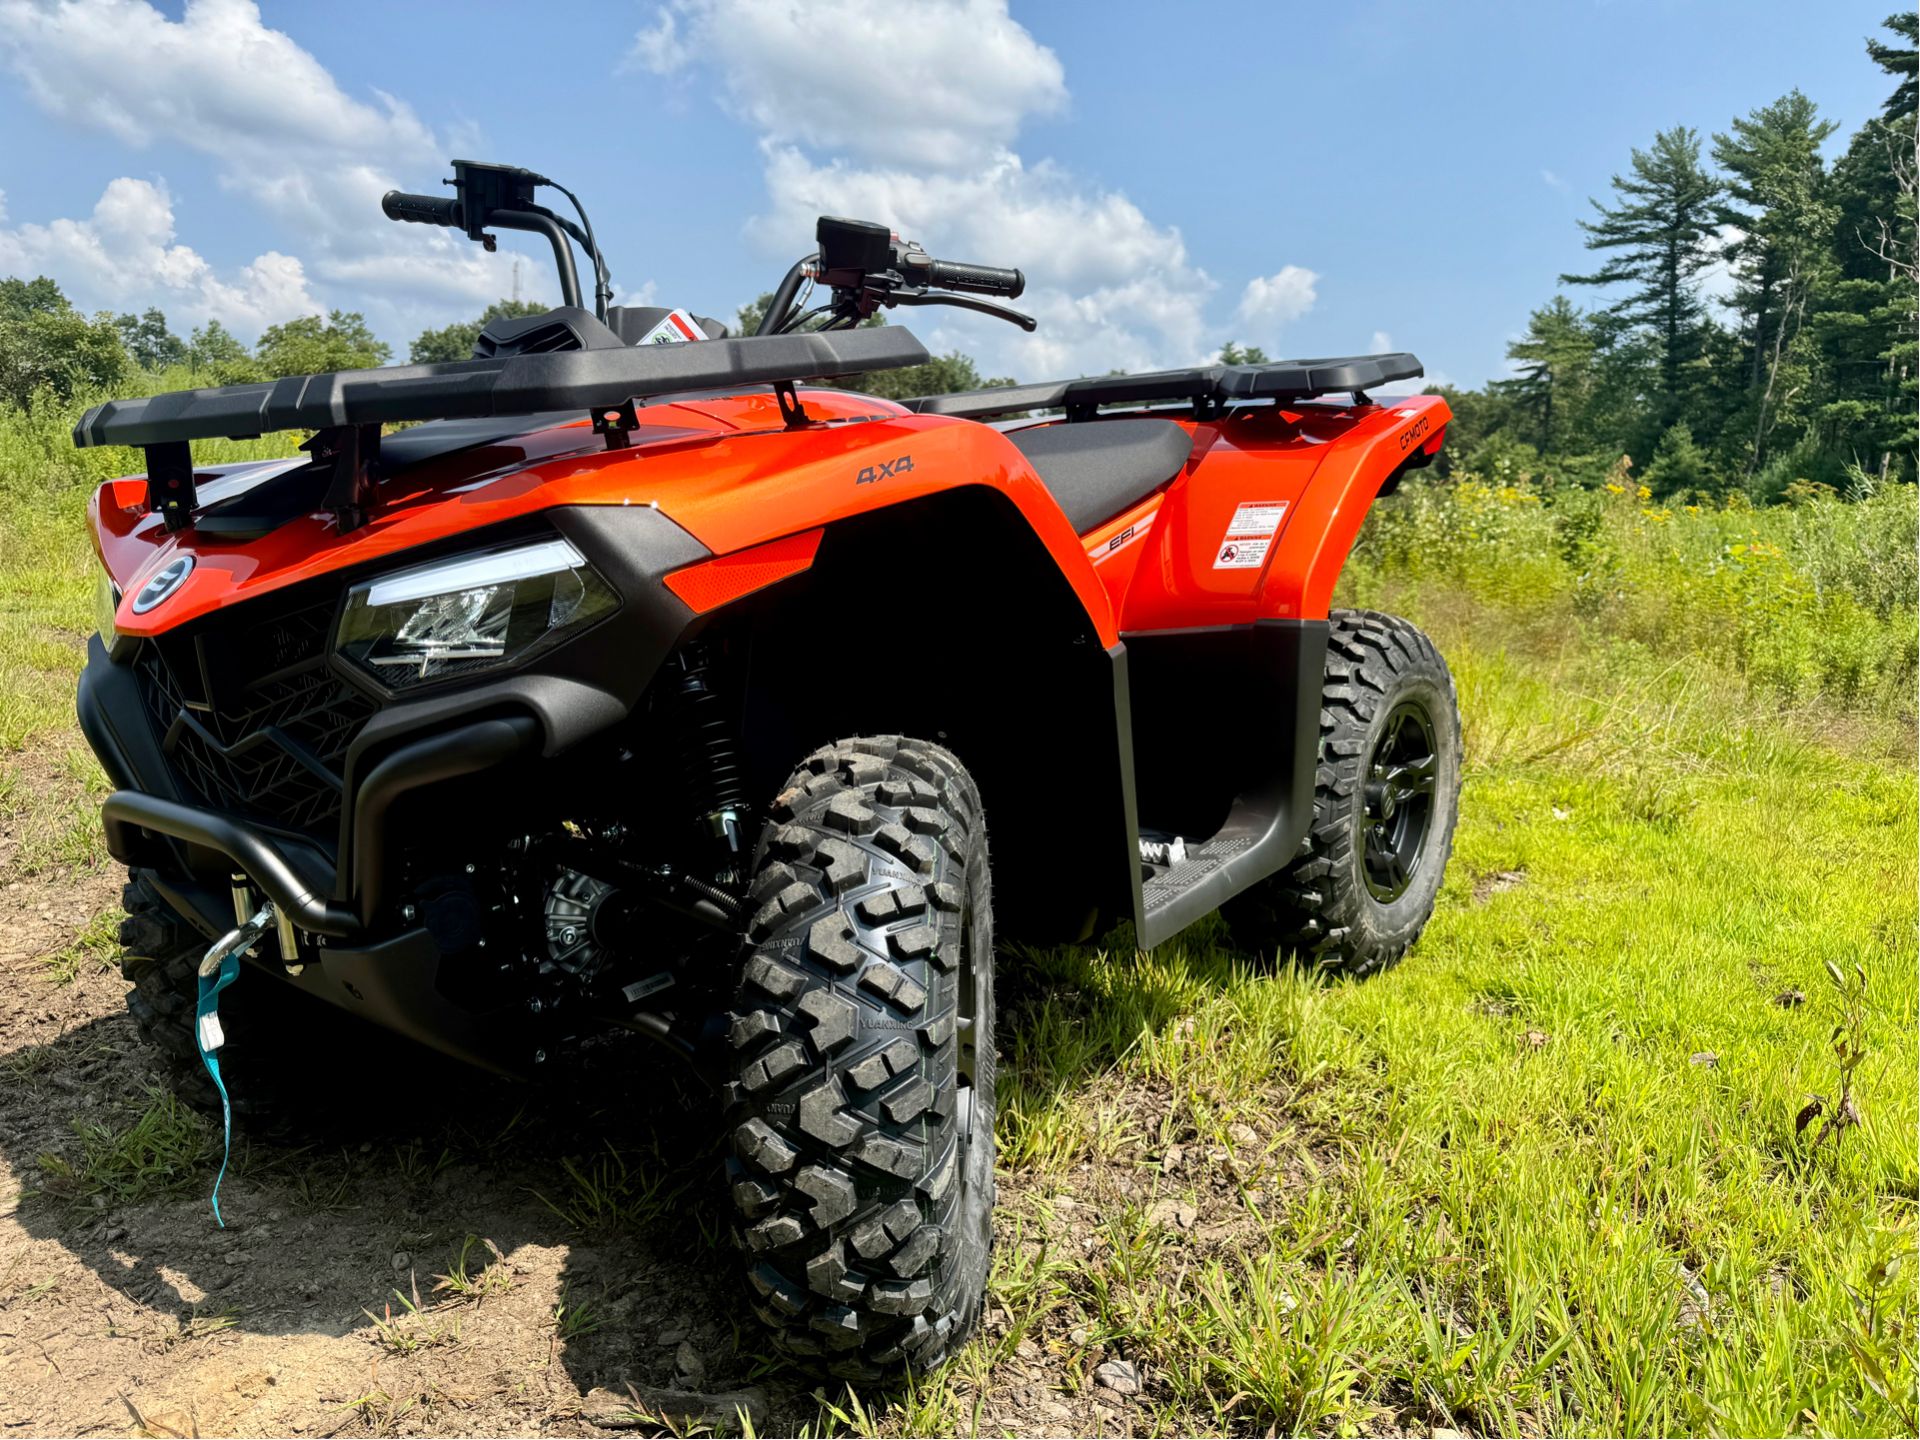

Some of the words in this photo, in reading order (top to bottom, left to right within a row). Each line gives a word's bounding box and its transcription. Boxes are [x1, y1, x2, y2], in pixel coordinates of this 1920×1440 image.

[1400, 416, 1429, 451] CFMOTO
[1109, 526, 1134, 551] EFI
[860, 1018, 913, 1030] YUANXING
